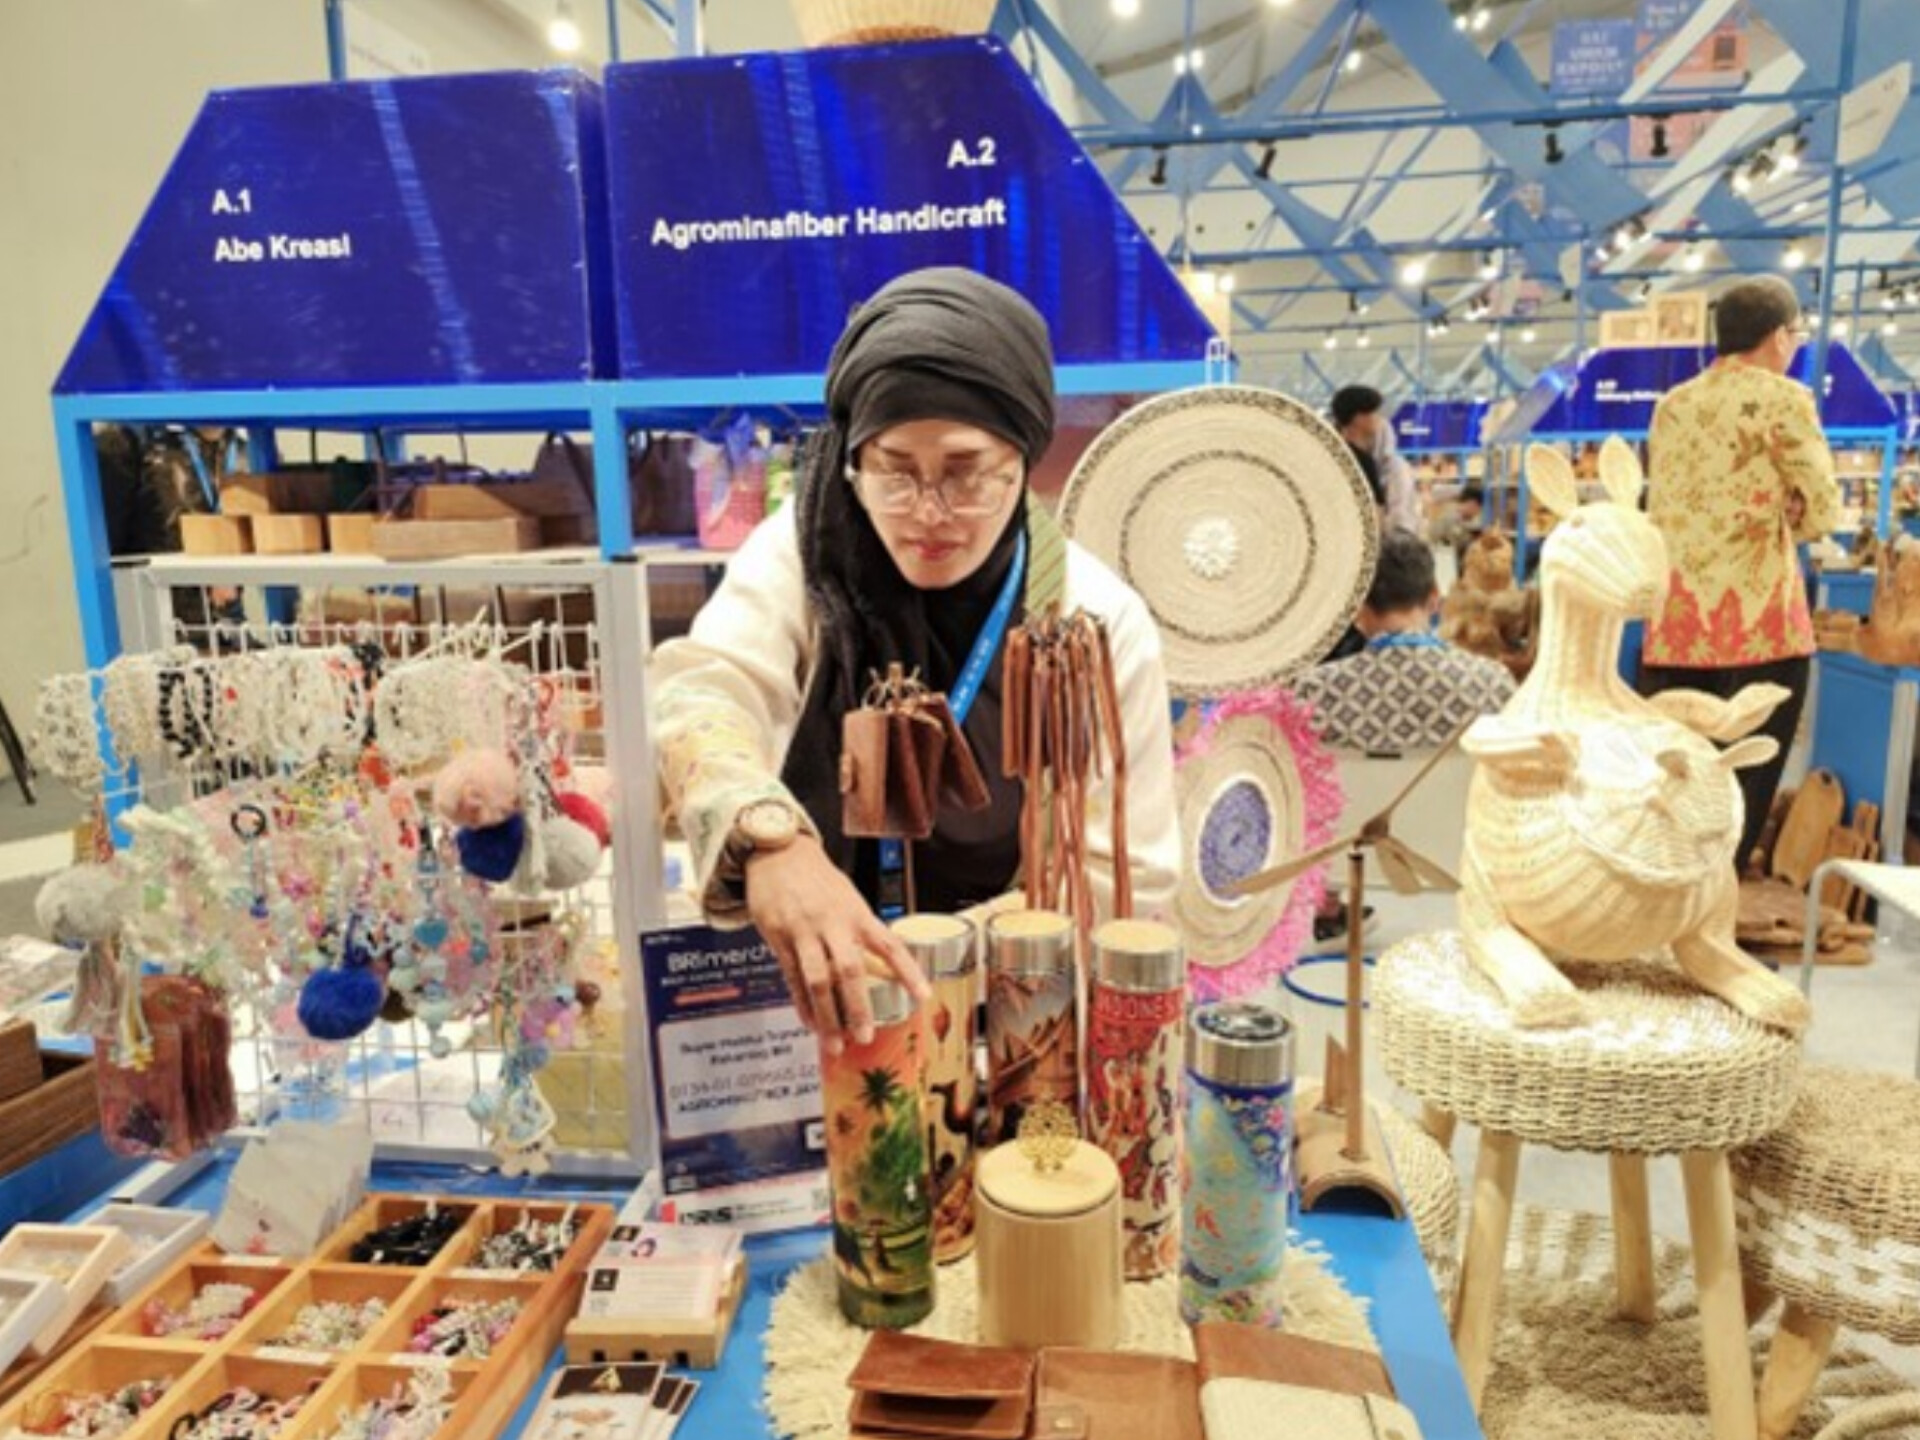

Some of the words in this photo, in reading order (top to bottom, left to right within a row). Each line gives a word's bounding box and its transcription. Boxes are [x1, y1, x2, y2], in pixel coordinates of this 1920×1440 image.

[947, 137, 996, 168] A.2
[212, 188, 251, 215] A.1
[652, 211, 849, 250] Agrominafiber
[855, 198, 1006, 235] Handicraft
[214, 237, 264, 262] Abe
[269, 232, 352, 260] Kreasi
